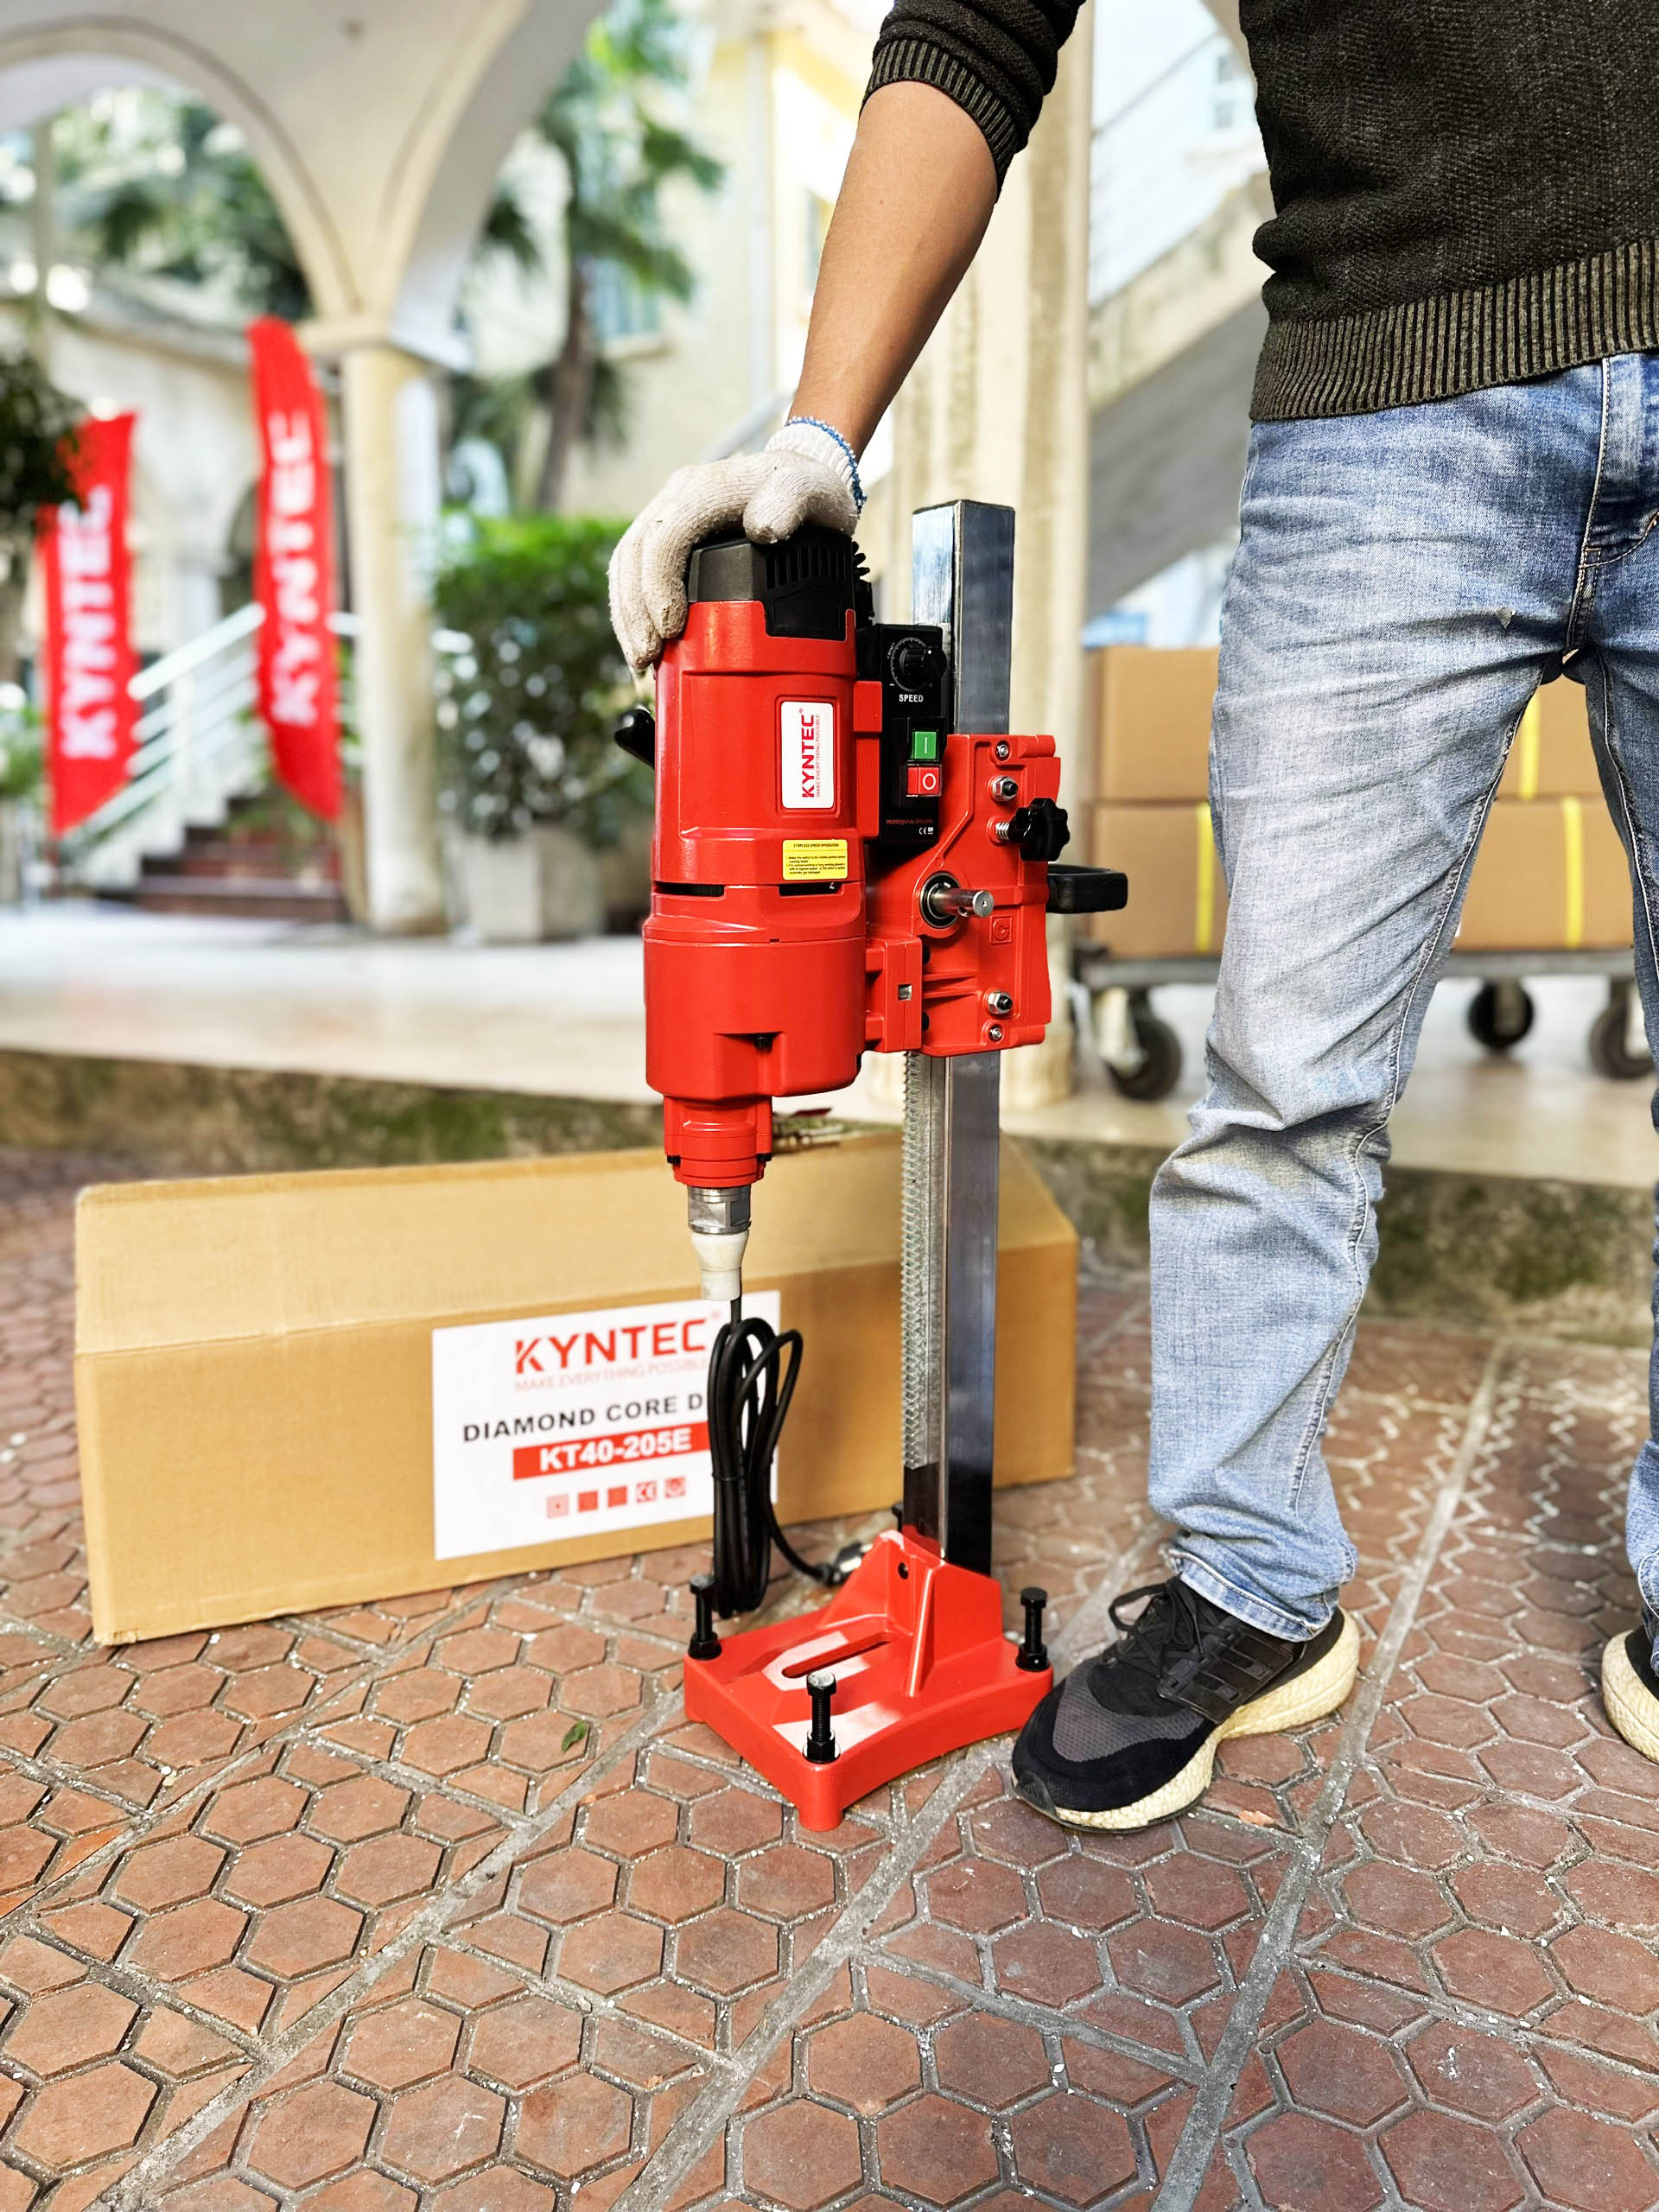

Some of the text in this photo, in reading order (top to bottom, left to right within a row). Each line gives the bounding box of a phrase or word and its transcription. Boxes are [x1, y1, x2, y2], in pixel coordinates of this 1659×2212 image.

[266, 410, 321, 726] KYNTEC
[58, 486, 118, 759] KYNTEC
[899, 694, 924, 702] SPEED
[801, 714, 815, 798] KYNTEC
[516, 1318, 707, 1374] KYNTEC
[463, 1394, 703, 1442] DIAMOND CORE D
[539, 1427, 692, 1472] KT40-205E
